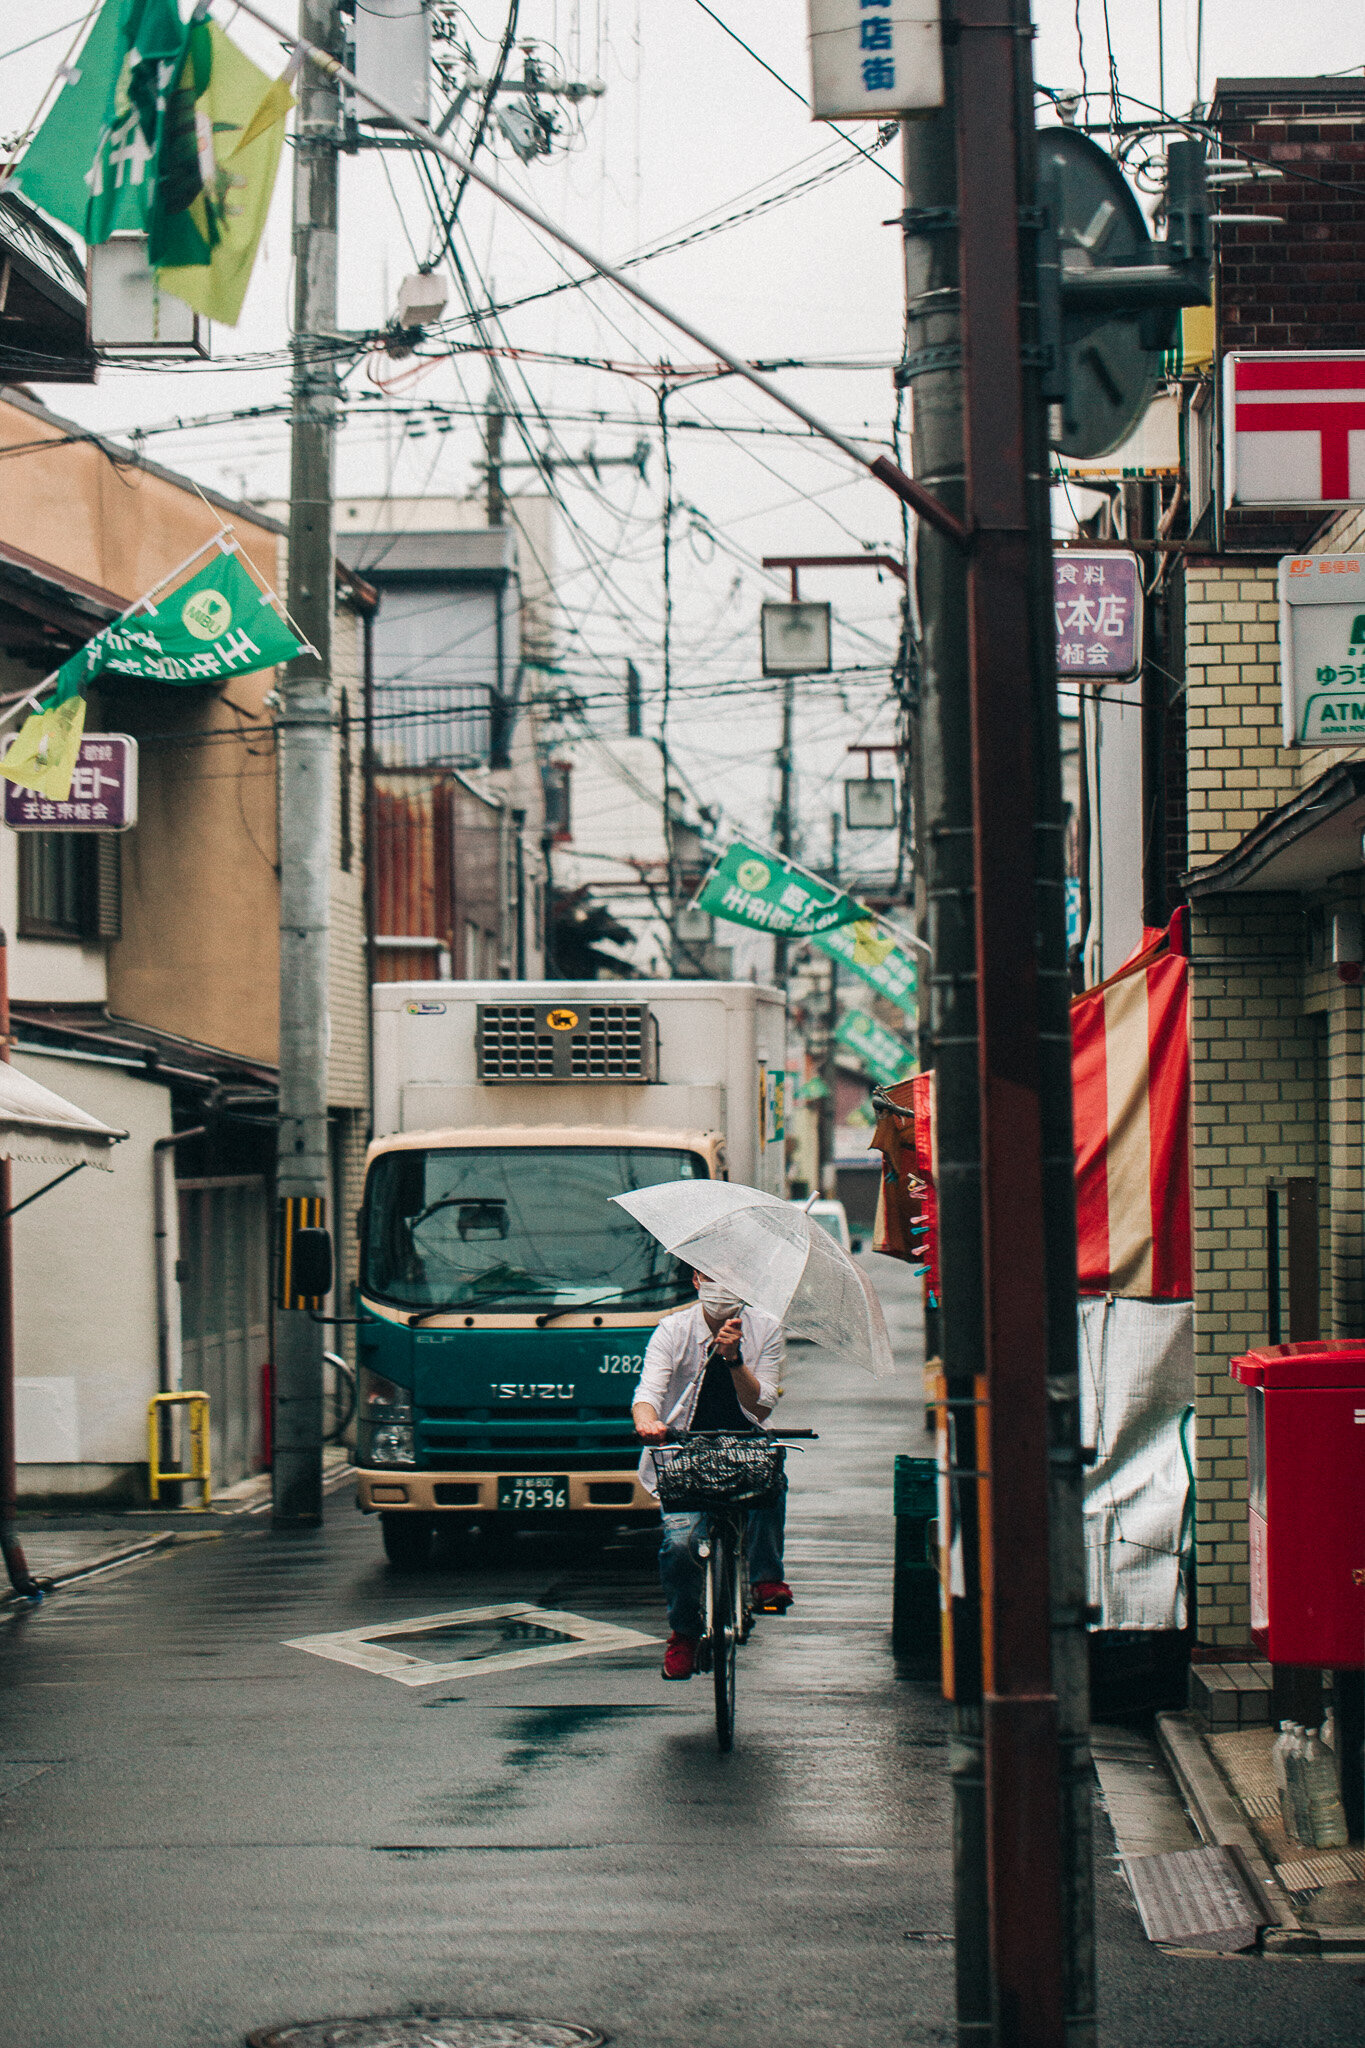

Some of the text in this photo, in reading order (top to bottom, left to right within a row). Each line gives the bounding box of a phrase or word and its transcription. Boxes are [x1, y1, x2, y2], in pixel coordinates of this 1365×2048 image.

[860, 0, 895, 91] 店街
[416, 1335, 455, 1344] ELF
[491, 1384, 575, 1399] ISUZU
